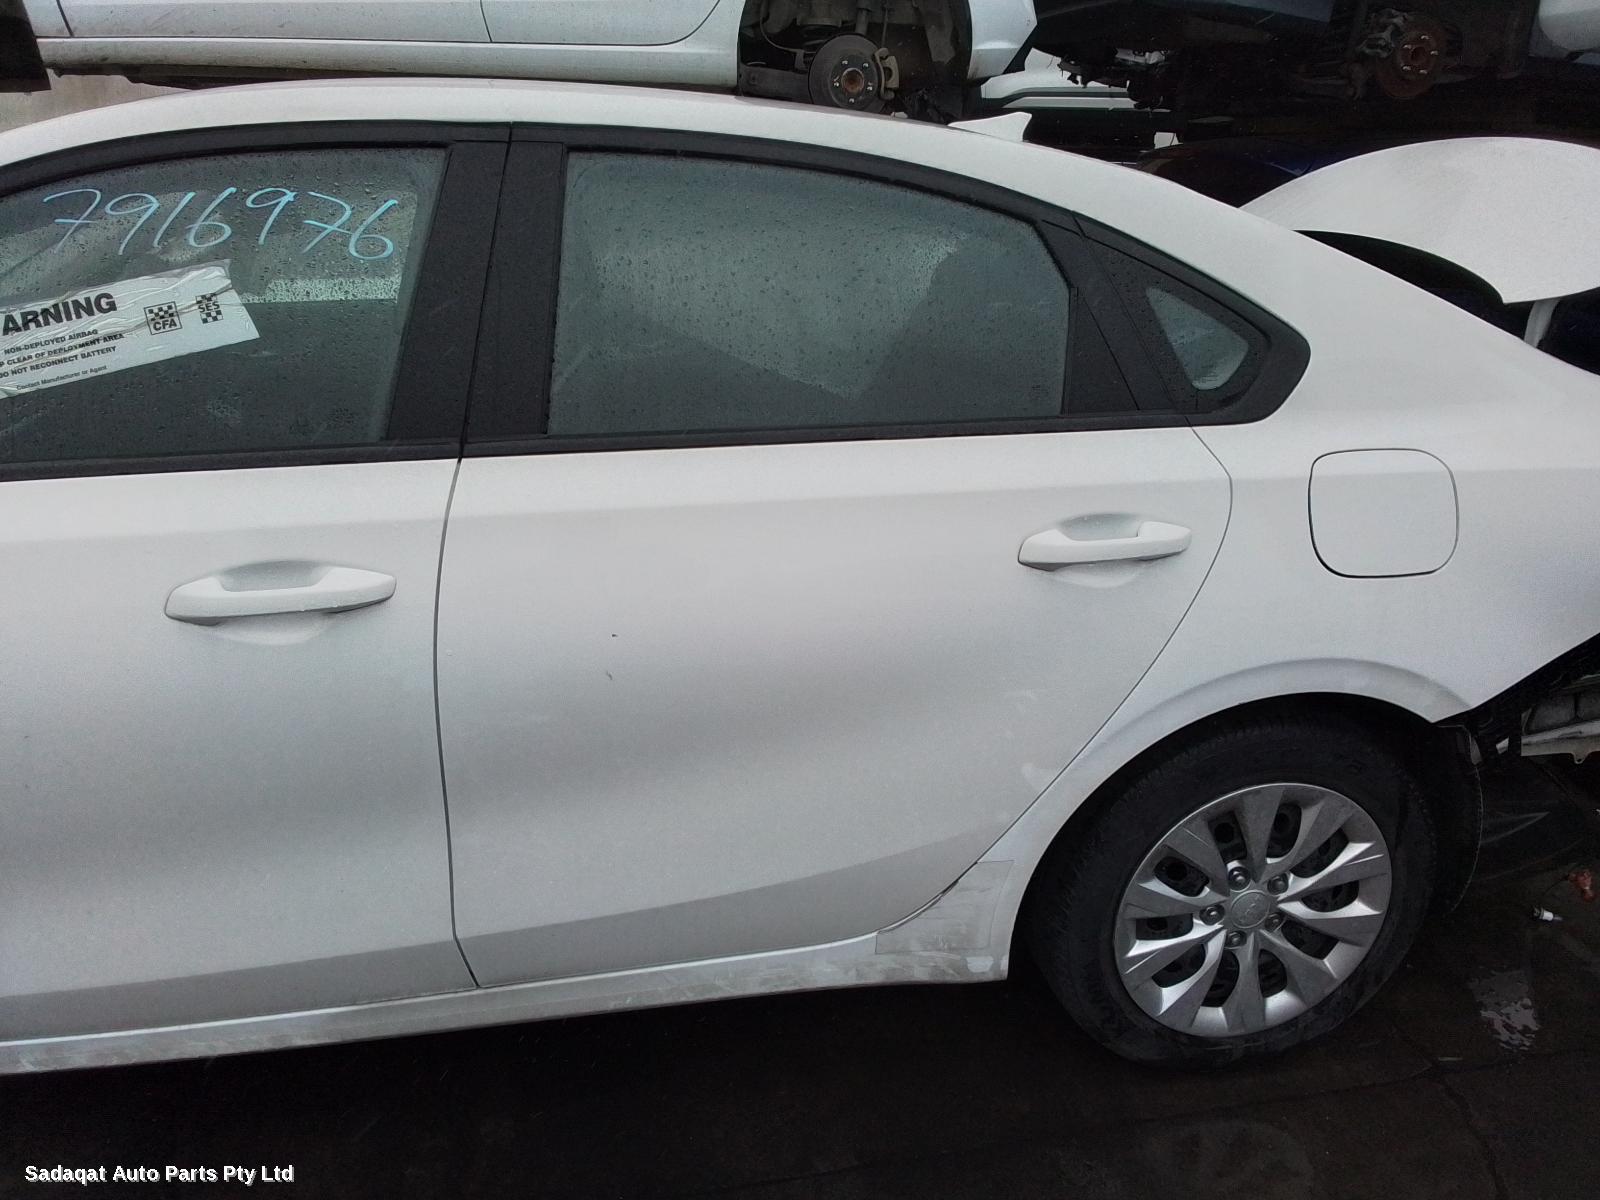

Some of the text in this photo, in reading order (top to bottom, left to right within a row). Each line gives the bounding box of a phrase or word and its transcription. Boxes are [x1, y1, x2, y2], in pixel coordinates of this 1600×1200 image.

[43, 187, 399, 260] 7916976
[198, 301, 220, 313] SES
[153, 318, 178, 332] CFA
[4, 329, 98, 355] NON-DEPLOYED AIRBAG
[7, 354, 33, 365] CLEAR
[35, 351, 46, 359] OF
[48, 337, 101, 356] DEPLOYMENT
[103, 333, 125, 343] AREA
[11, 366, 28, 376] NOT
[30, 354, 79, 371] RECONNECT
[80, 345, 116, 359] BATTERY
[16, 381, 41, 390] Contact
[89, 365, 107, 374] Agent
